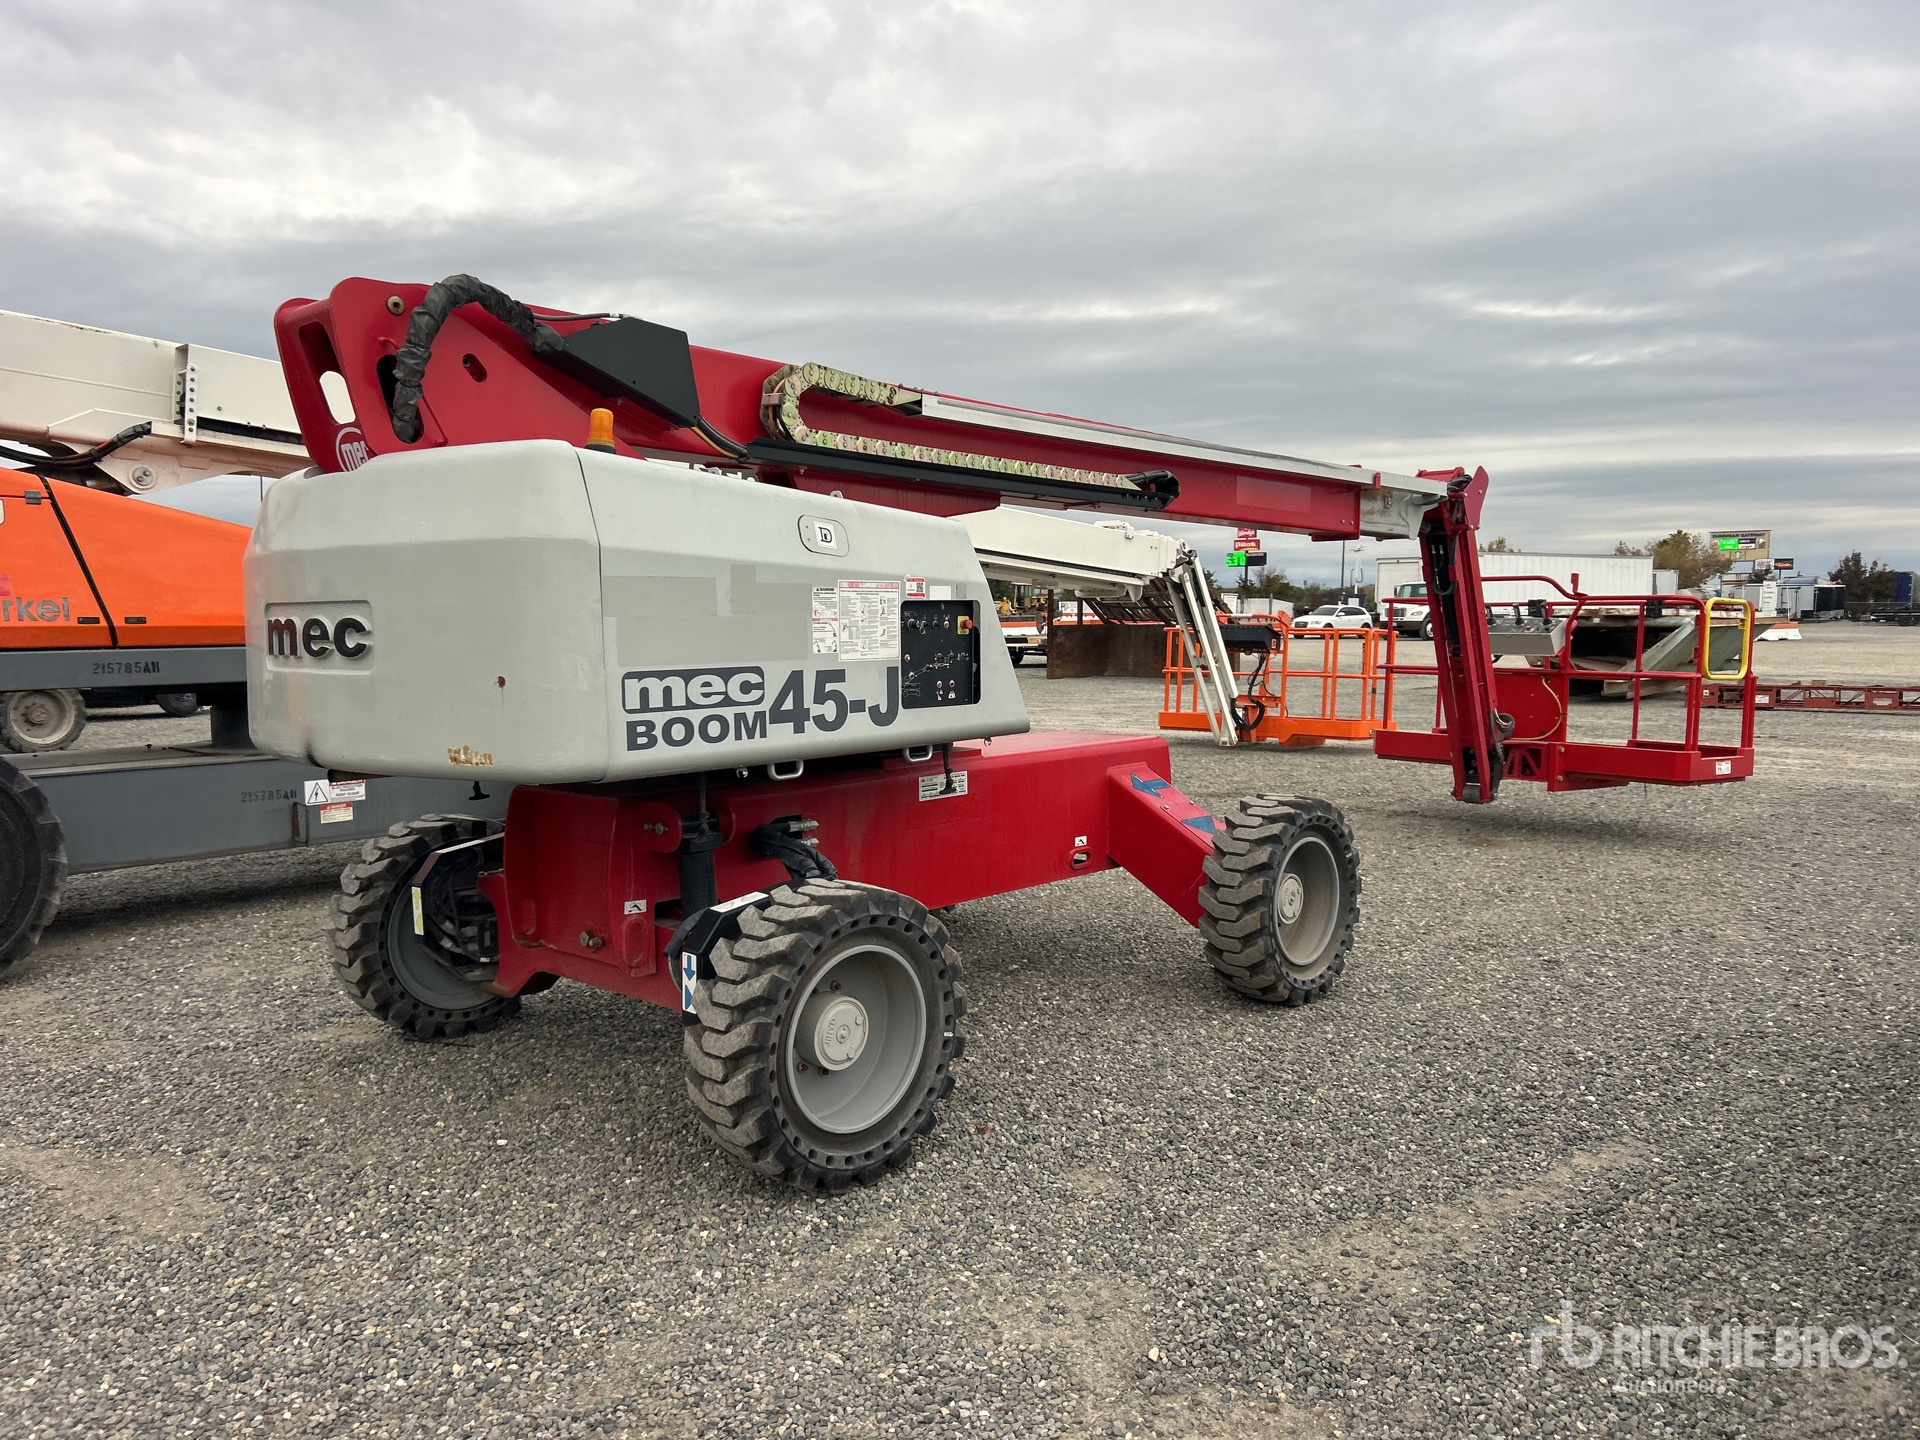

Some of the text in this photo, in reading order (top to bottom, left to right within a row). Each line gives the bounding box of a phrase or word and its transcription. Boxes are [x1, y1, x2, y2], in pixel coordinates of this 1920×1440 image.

[267, 616, 369, 658] mec
[624, 672, 764, 711] mec
[626, 666, 899, 751] BOOM 45-J
